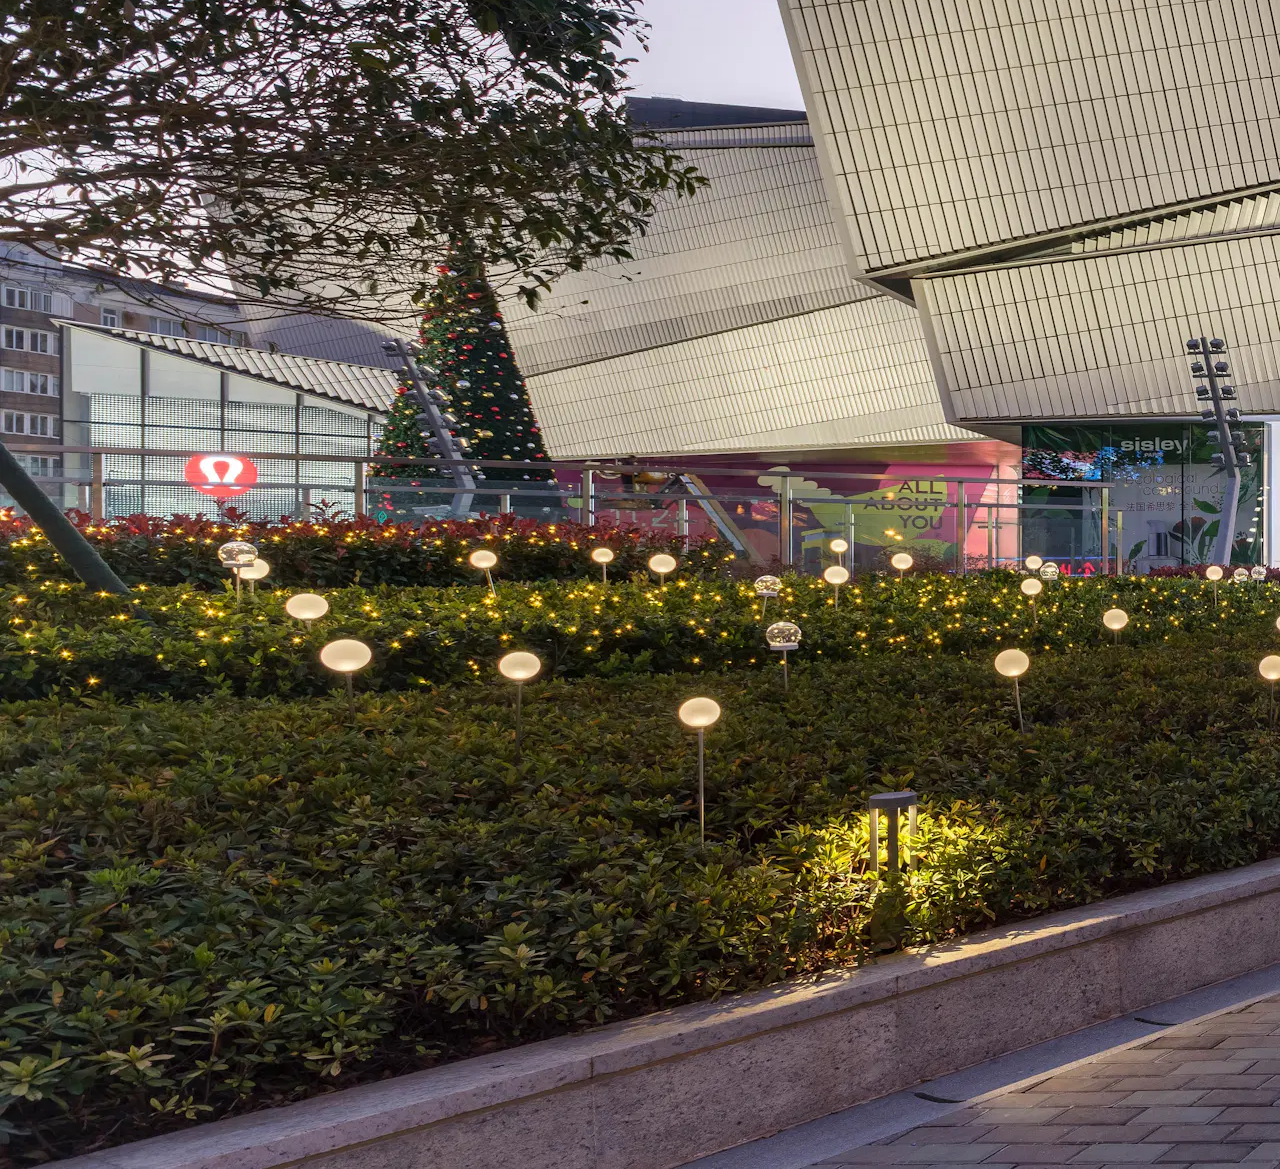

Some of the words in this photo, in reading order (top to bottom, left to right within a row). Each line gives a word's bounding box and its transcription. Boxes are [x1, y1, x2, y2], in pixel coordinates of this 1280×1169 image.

[1120, 437, 1188, 454] sisley
[898, 479, 943, 495] ALL
[1125, 472, 1197, 486] ecological
[863, 496, 943, 512] ABOUT
[898, 514, 943, 530] YOU
